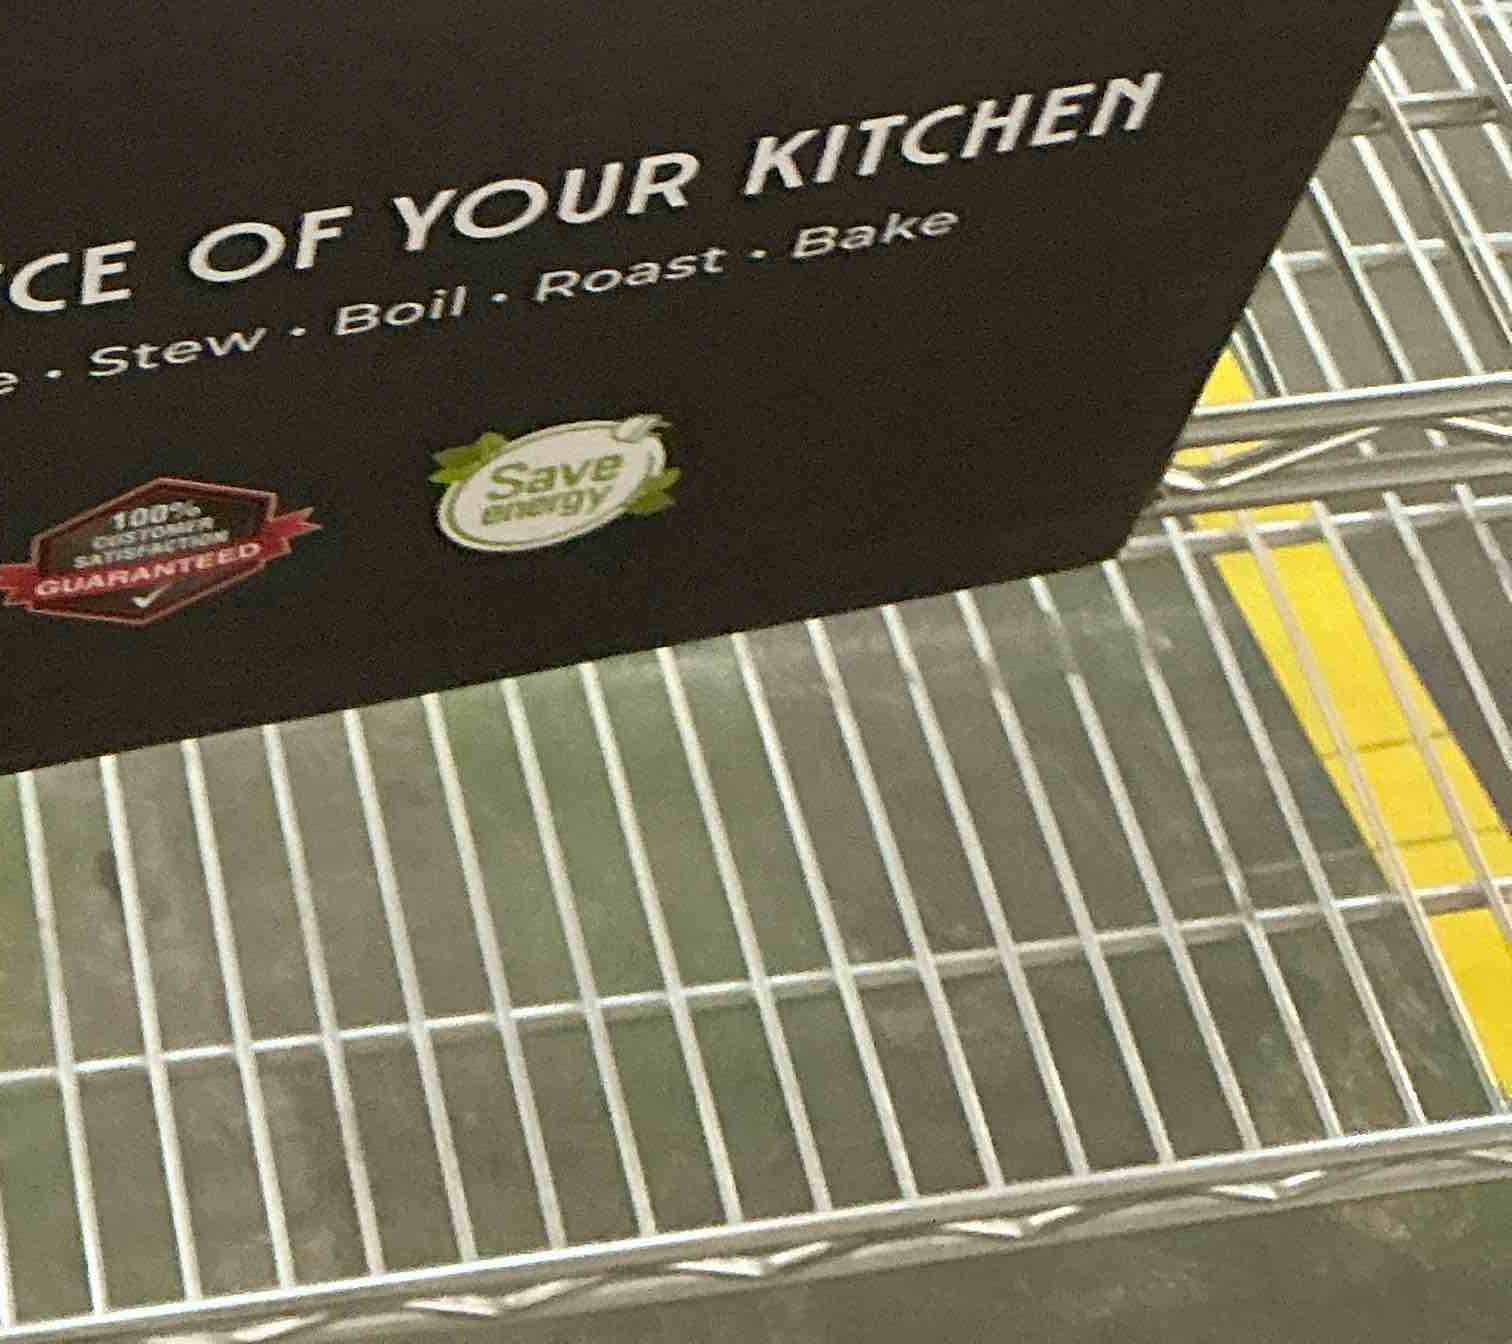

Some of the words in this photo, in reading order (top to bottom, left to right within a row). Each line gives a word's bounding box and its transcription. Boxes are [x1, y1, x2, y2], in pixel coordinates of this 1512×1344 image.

[187, 205, 353, 284] OF
[392, 152, 701, 252] YOUR
[742, 71, 1163, 198] KITCHEN
[88, 325, 268, 379] Stew
[333, 284, 468, 338] Boil
[534, 244, 727, 303] Roast
[791, 204, 961, 261] Bake
[486, 453, 624, 500] Save
[114, 500, 202, 531] 100%
[34, 543, 262, 597] GUARANTEED
